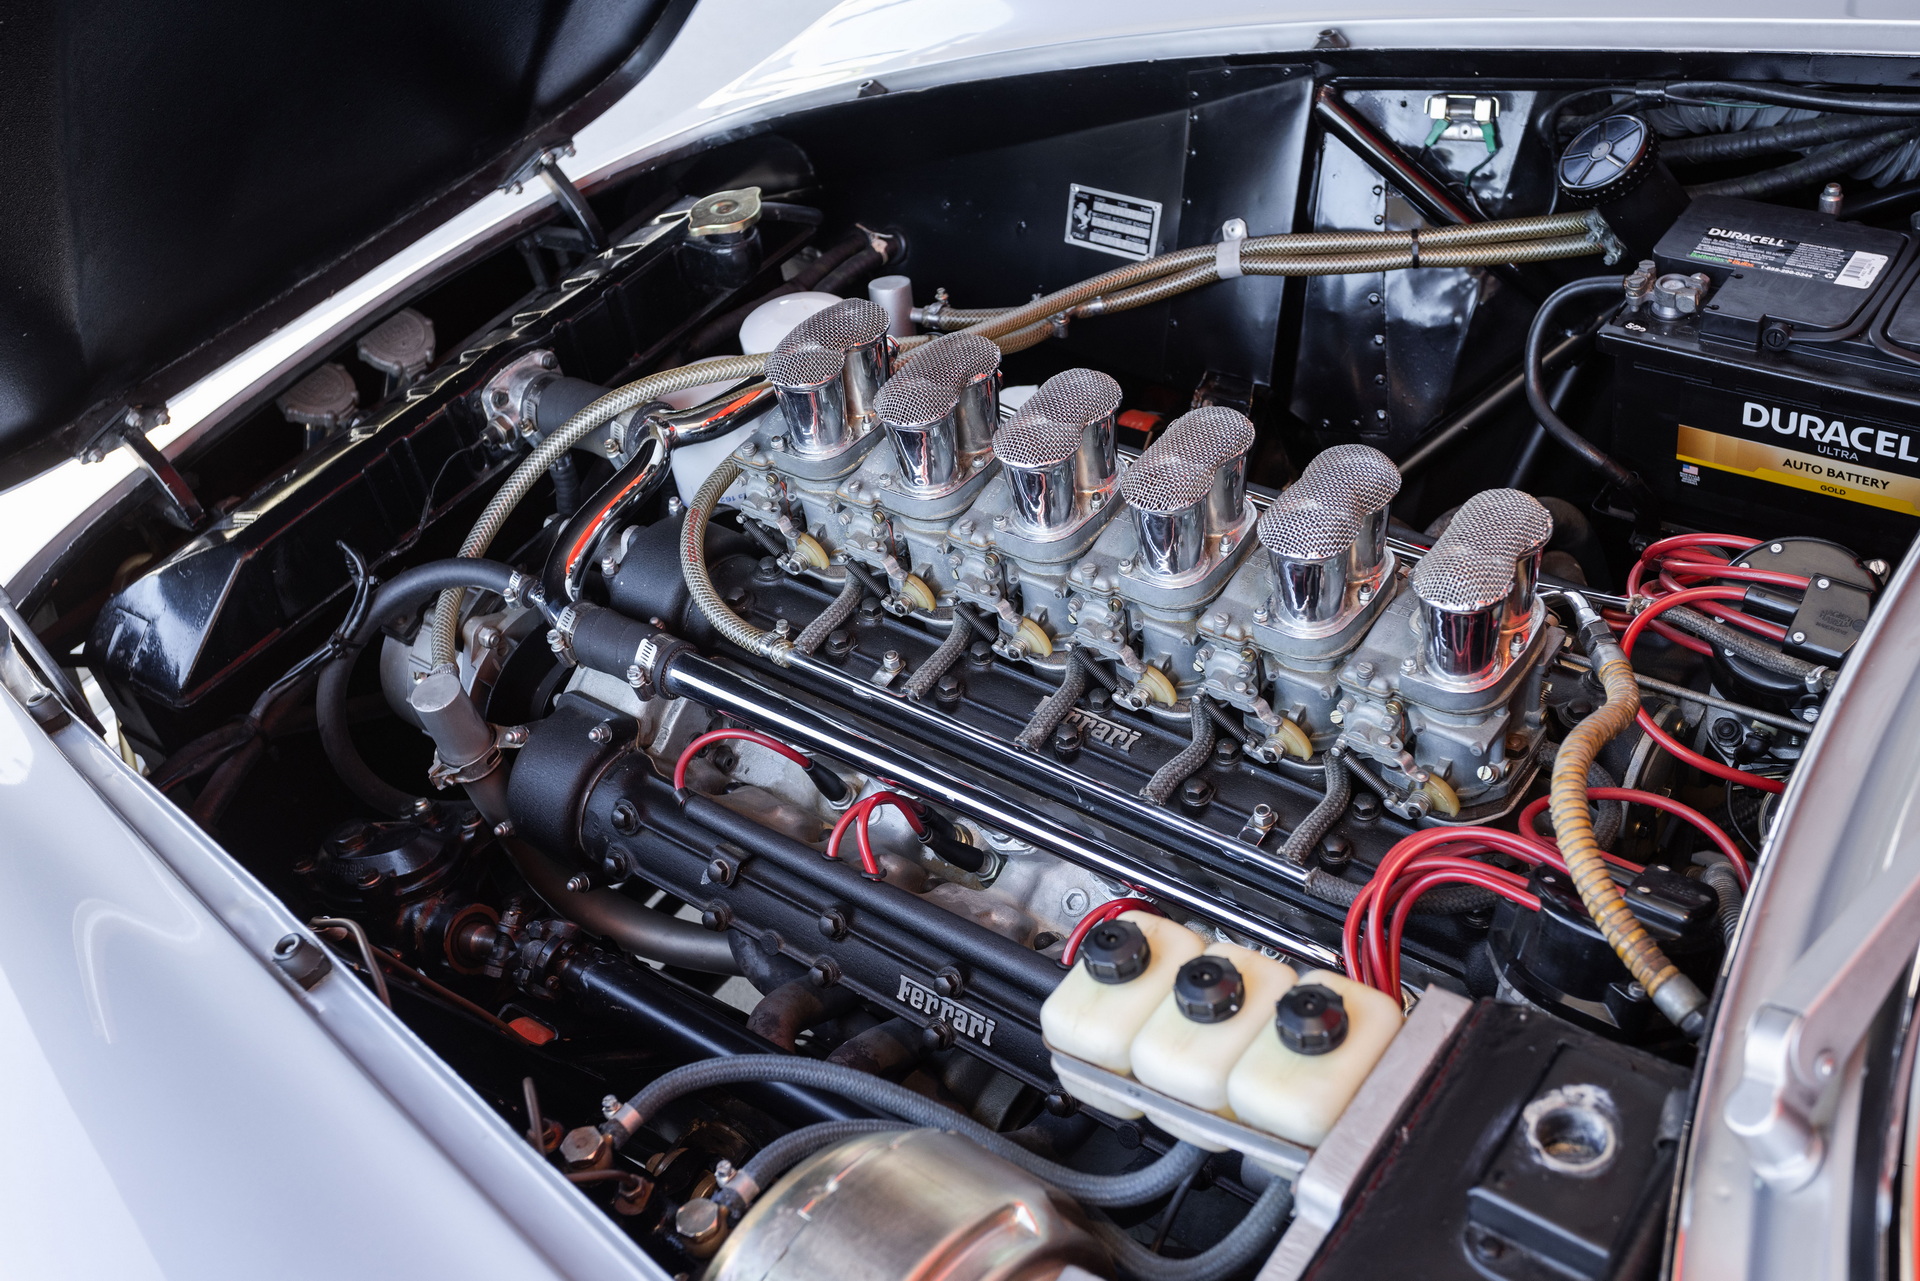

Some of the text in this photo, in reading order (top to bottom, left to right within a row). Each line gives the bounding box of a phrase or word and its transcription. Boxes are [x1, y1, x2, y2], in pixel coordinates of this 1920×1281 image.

[1707, 227, 1785, 248] DURACELL
[1817, 444, 1859, 461] ULTRA
[1782, 458, 1890, 490] AUTO BATTERY
[1820, 484, 1846, 496] GOLD
[896, 974, 997, 1047] Ferrari
